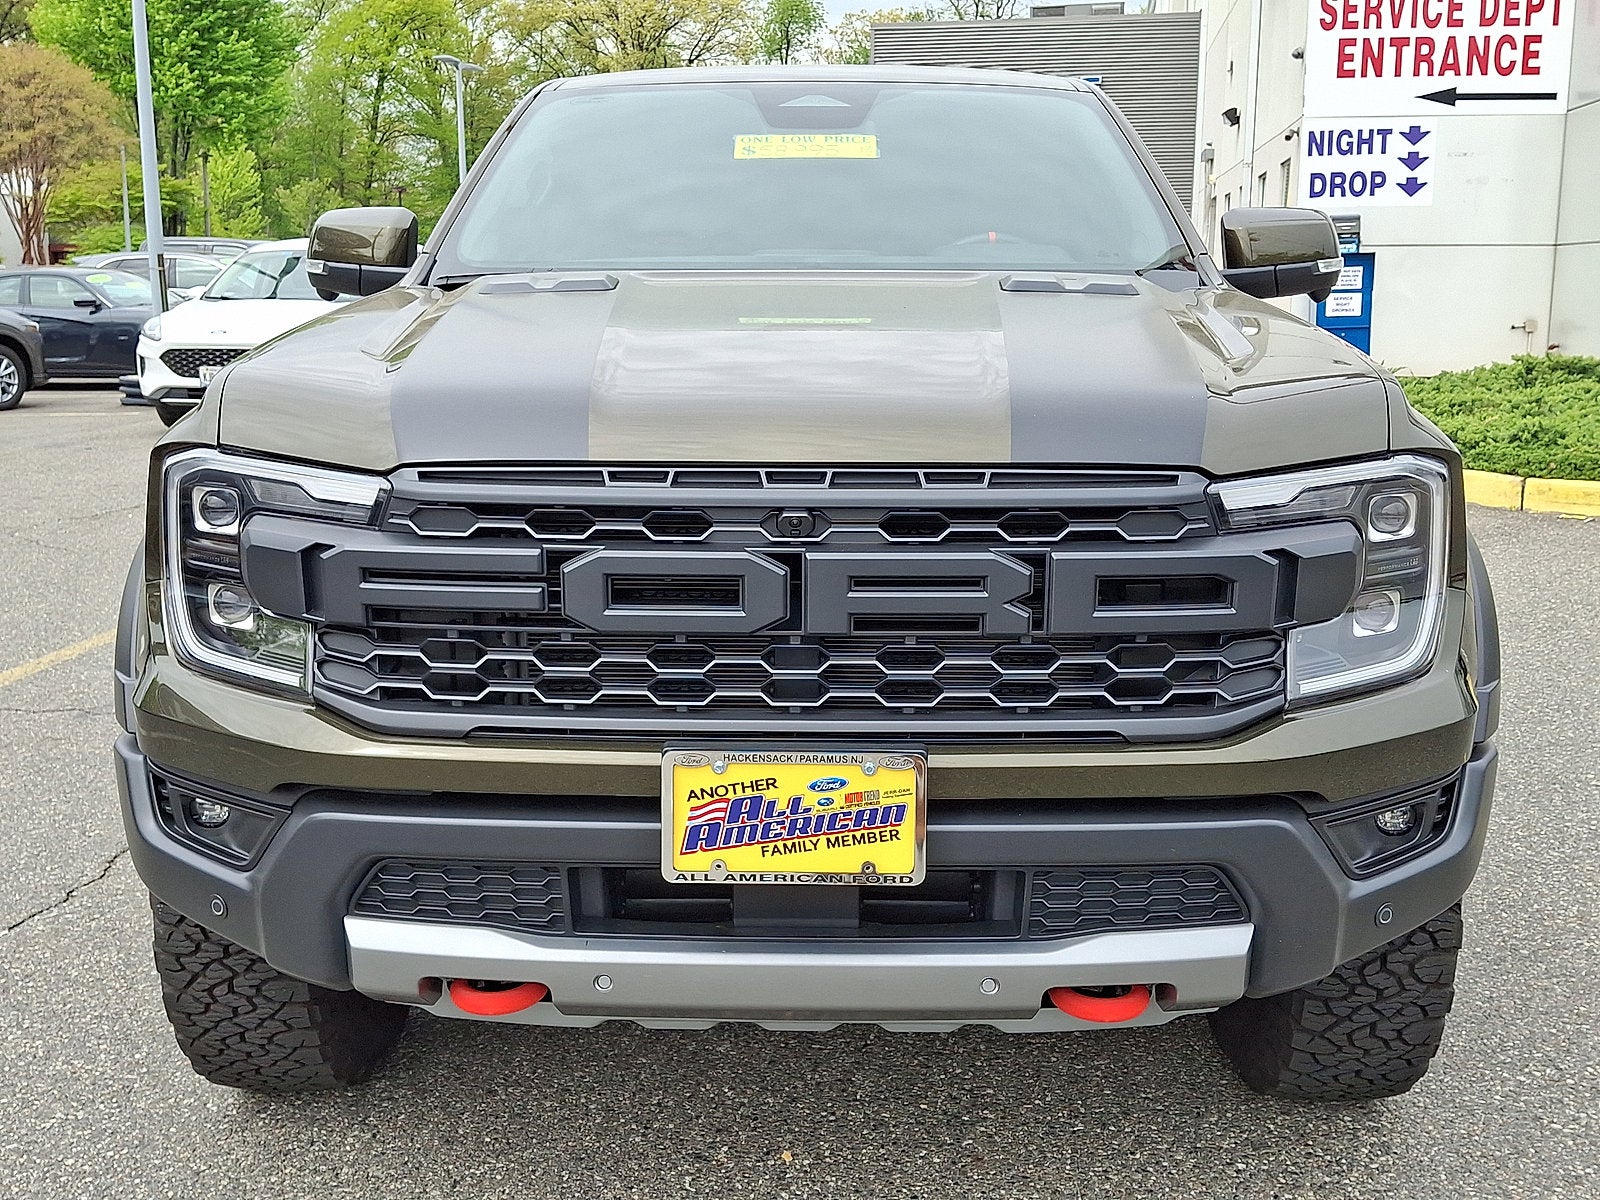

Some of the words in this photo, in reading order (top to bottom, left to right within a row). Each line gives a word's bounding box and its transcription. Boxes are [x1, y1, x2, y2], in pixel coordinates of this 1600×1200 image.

[1319, 0, 1464, 31] SERVICE
[1336, 35, 1542, 78] ENTRANCE
[741, 135, 774, 143] ONE
[782, 135, 816, 143] LOW
[824, 135, 871, 143] PRICE
[1307, 129, 1393, 156] NIGHT
[1309, 171, 1387, 198] DROP
[318, 544, 1278, 636] FORD
[680, 755, 704, 765] Ford
[850, 755, 864, 764] NJ
[687, 777, 779, 803] ANOTHER
[814, 778, 841, 791] Ford
[844, 792, 863, 805] MOTOR
[760, 837, 821, 858] FAMILY
[826, 829, 901, 849] MEMBER
[673, 873, 716, 882] ALL
[722, 873, 844, 883] AMERICAN
[852, 874, 914, 884] FORD
